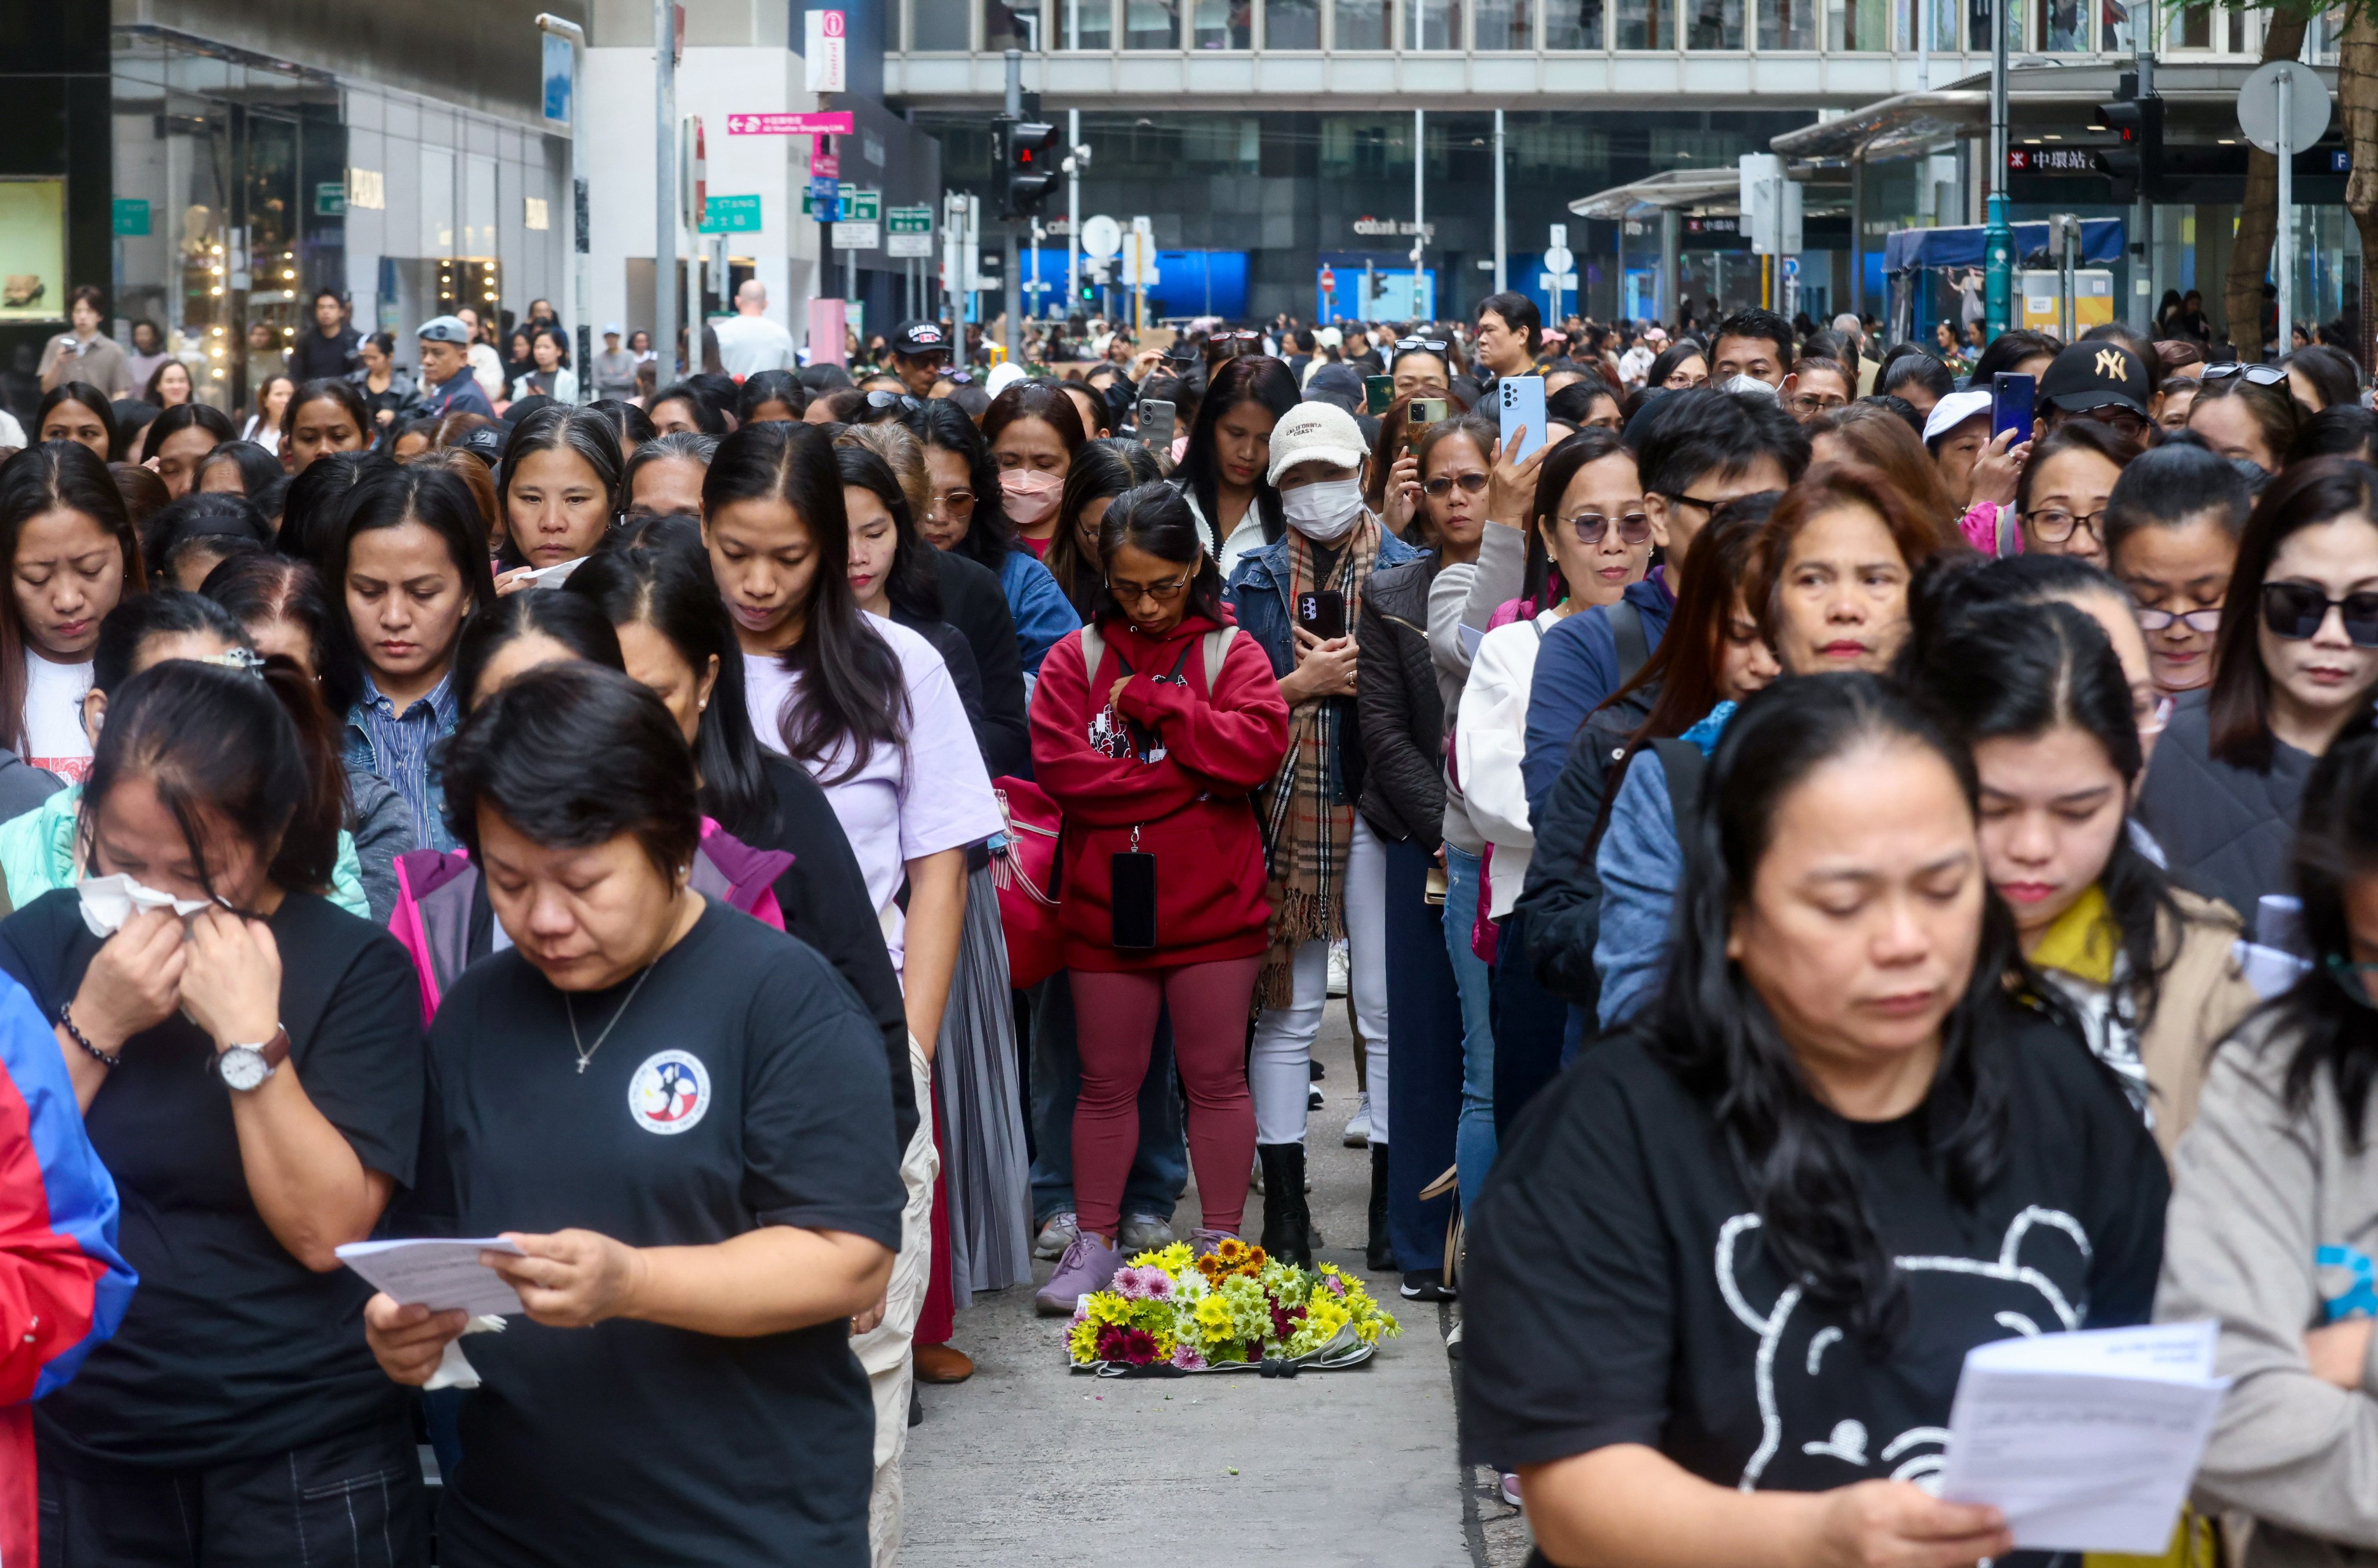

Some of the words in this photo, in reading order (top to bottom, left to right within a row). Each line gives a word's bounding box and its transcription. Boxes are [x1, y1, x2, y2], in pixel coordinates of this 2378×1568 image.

[829, 42, 838, 86] Central
[2033, 150, 2085, 169] 中環站
[2338, 153, 2346, 168] F
[2095, 348, 2128, 383] NY
[1286, 423, 1322, 436] CALIFORNIA
[1294, 428, 1313, 437] COAST
